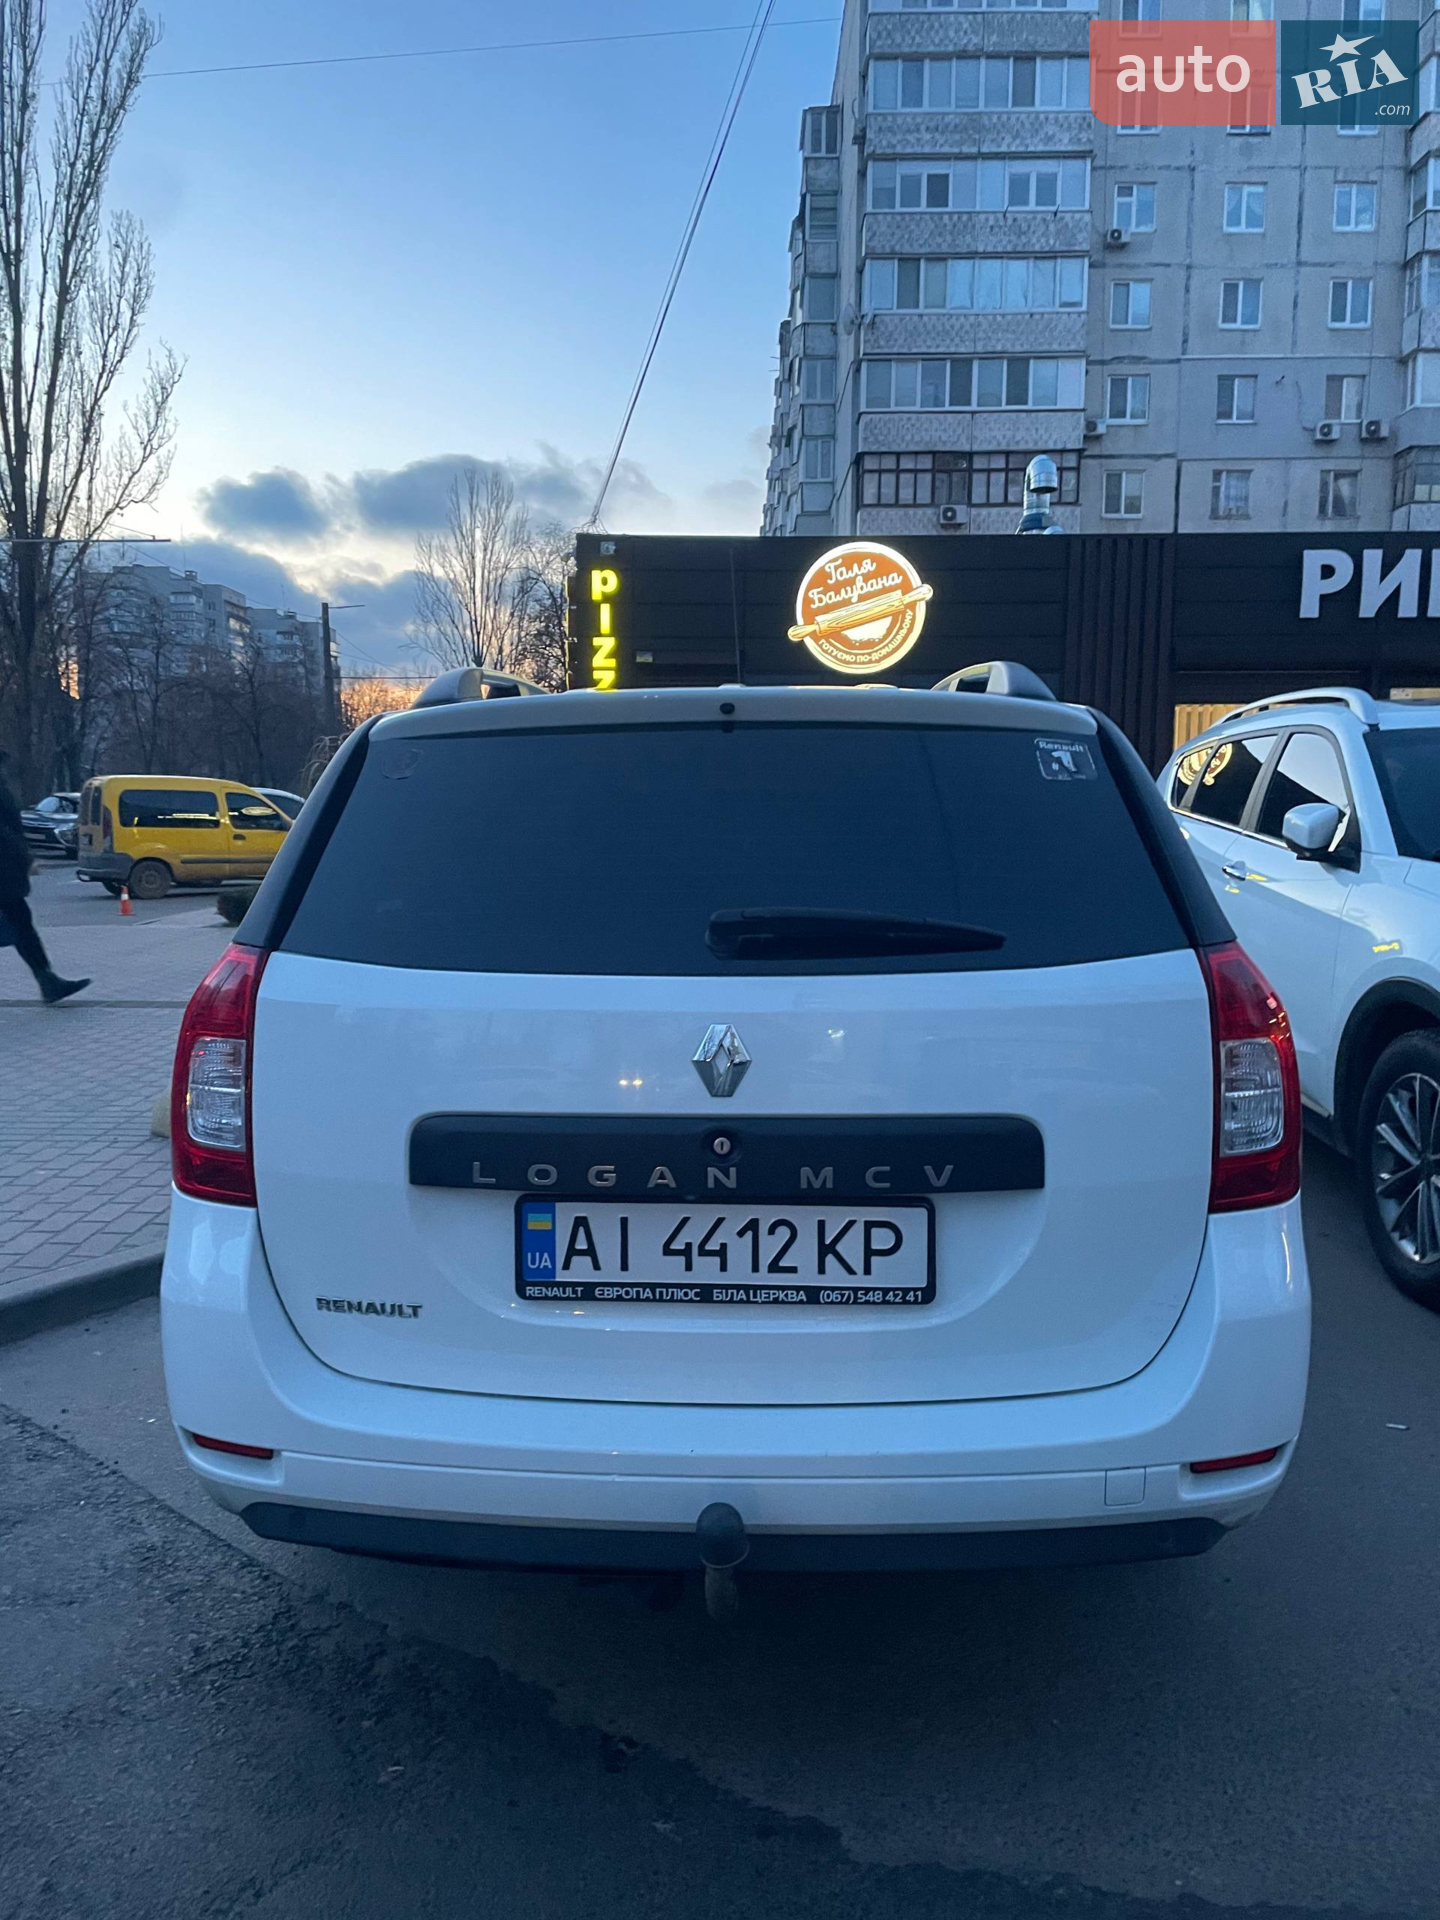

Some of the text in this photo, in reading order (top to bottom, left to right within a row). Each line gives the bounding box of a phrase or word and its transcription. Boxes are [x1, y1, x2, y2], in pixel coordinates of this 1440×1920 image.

[824, 558, 877, 584] Галя
[808, 571, 903, 609] Балувана
[472, 1161, 954, 1189] LOGAN MCV
[561, 1215, 903, 1276] AI 4412 KP
[527, 1251, 552, 1269] UA
[316, 1296, 422, 1319] RENAULT
[525, 1286, 923, 1304] RENAULT ЄВРОПА ПЛЮС БІЛА ЦЕРКВА (067) 548 42 41
